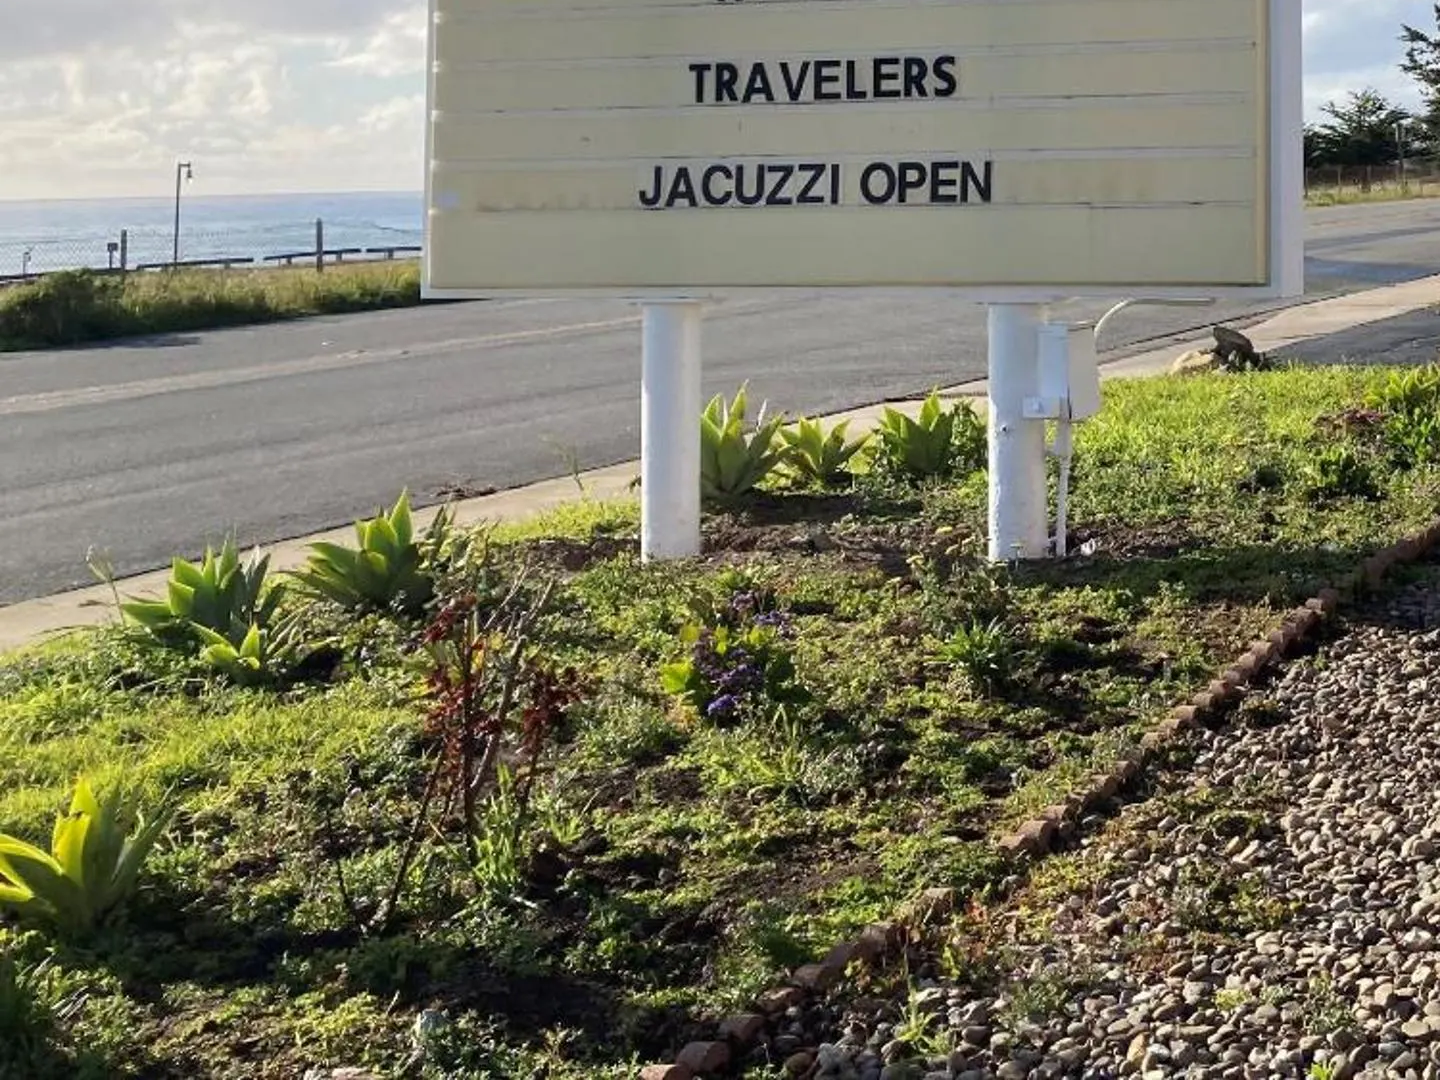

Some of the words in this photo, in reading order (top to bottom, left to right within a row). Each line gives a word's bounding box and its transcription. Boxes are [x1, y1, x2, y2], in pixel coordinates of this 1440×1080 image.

[688, 55, 957, 104] TRAVELERS
[639, 163, 840, 208] JACUZZI
[859, 160, 992, 205] OPEN
